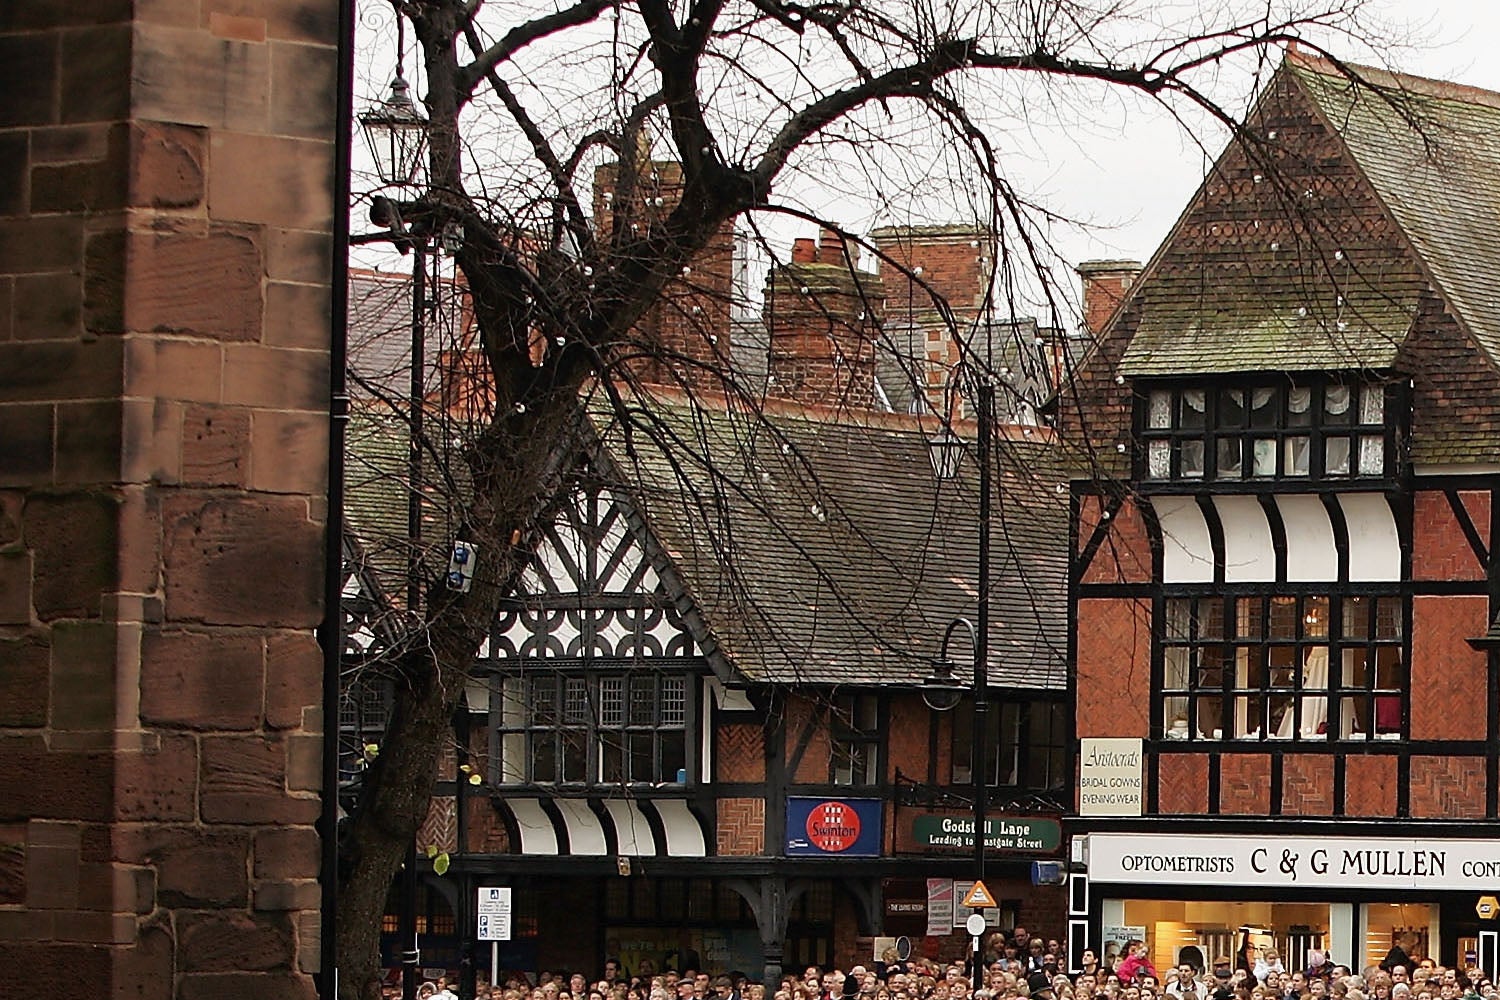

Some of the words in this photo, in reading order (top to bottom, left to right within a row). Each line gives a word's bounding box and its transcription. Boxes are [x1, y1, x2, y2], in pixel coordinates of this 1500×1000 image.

[1084, 745, 1140, 767] Aristocrats
[1082, 778, 1107, 788] BRIDAL
[1110, 778, 1140, 788] GOWNS
[1083, 794, 1116, 804] EVENING
[1117, 794, 1140, 804] WEAR
[812, 822, 856, 837] Swinton
[942, 818, 992, 834] Godstll
[1000, 821, 1030, 837] Lane
[929, 834, 962, 847] Leading
[965, 837, 974, 846] to
[983, 838, 1013, 849] astgate
[1016, 838, 1043, 849] Street
[1121, 855, 1234, 873] OPTOMETRISTS
[1250, 848, 1268, 874] C
[1279, 848, 1299, 881] &
[1310, 849, 1328, 875] G
[1340, 850, 1446, 877] MULLEN
